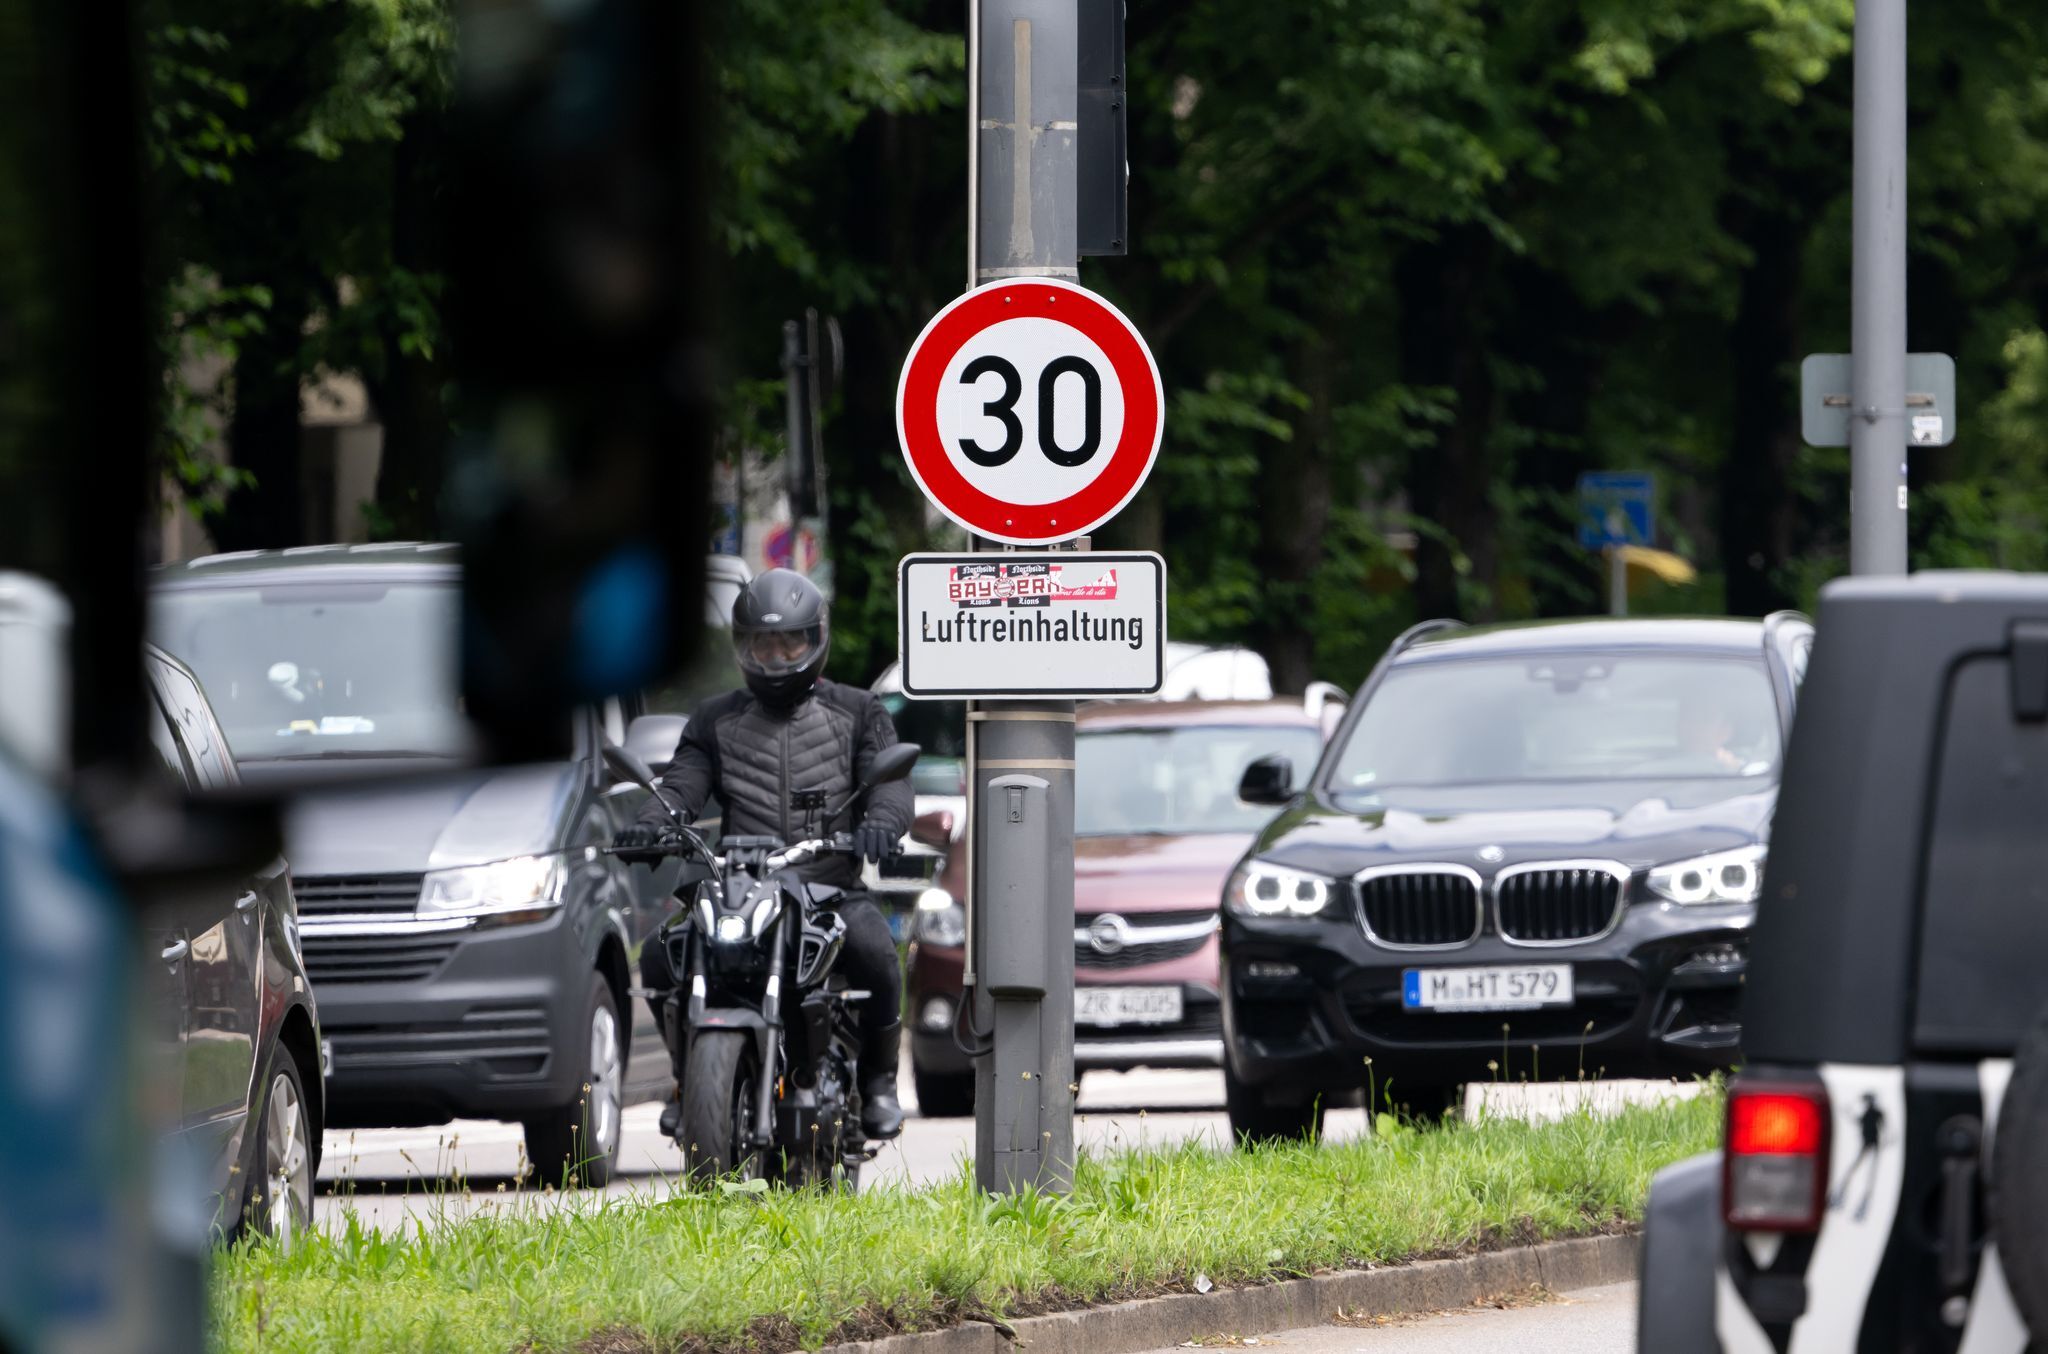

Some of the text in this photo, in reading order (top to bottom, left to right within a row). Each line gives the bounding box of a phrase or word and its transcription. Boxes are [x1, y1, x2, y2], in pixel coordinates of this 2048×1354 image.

[958, 355, 1102, 467] 30
[962, 565, 996, 575] Northside
[1011, 564, 1046, 574] Northside
[922, 610, 1143, 650] Luftreinhaltung
[1431, 970, 1559, 1000] M HT 579
